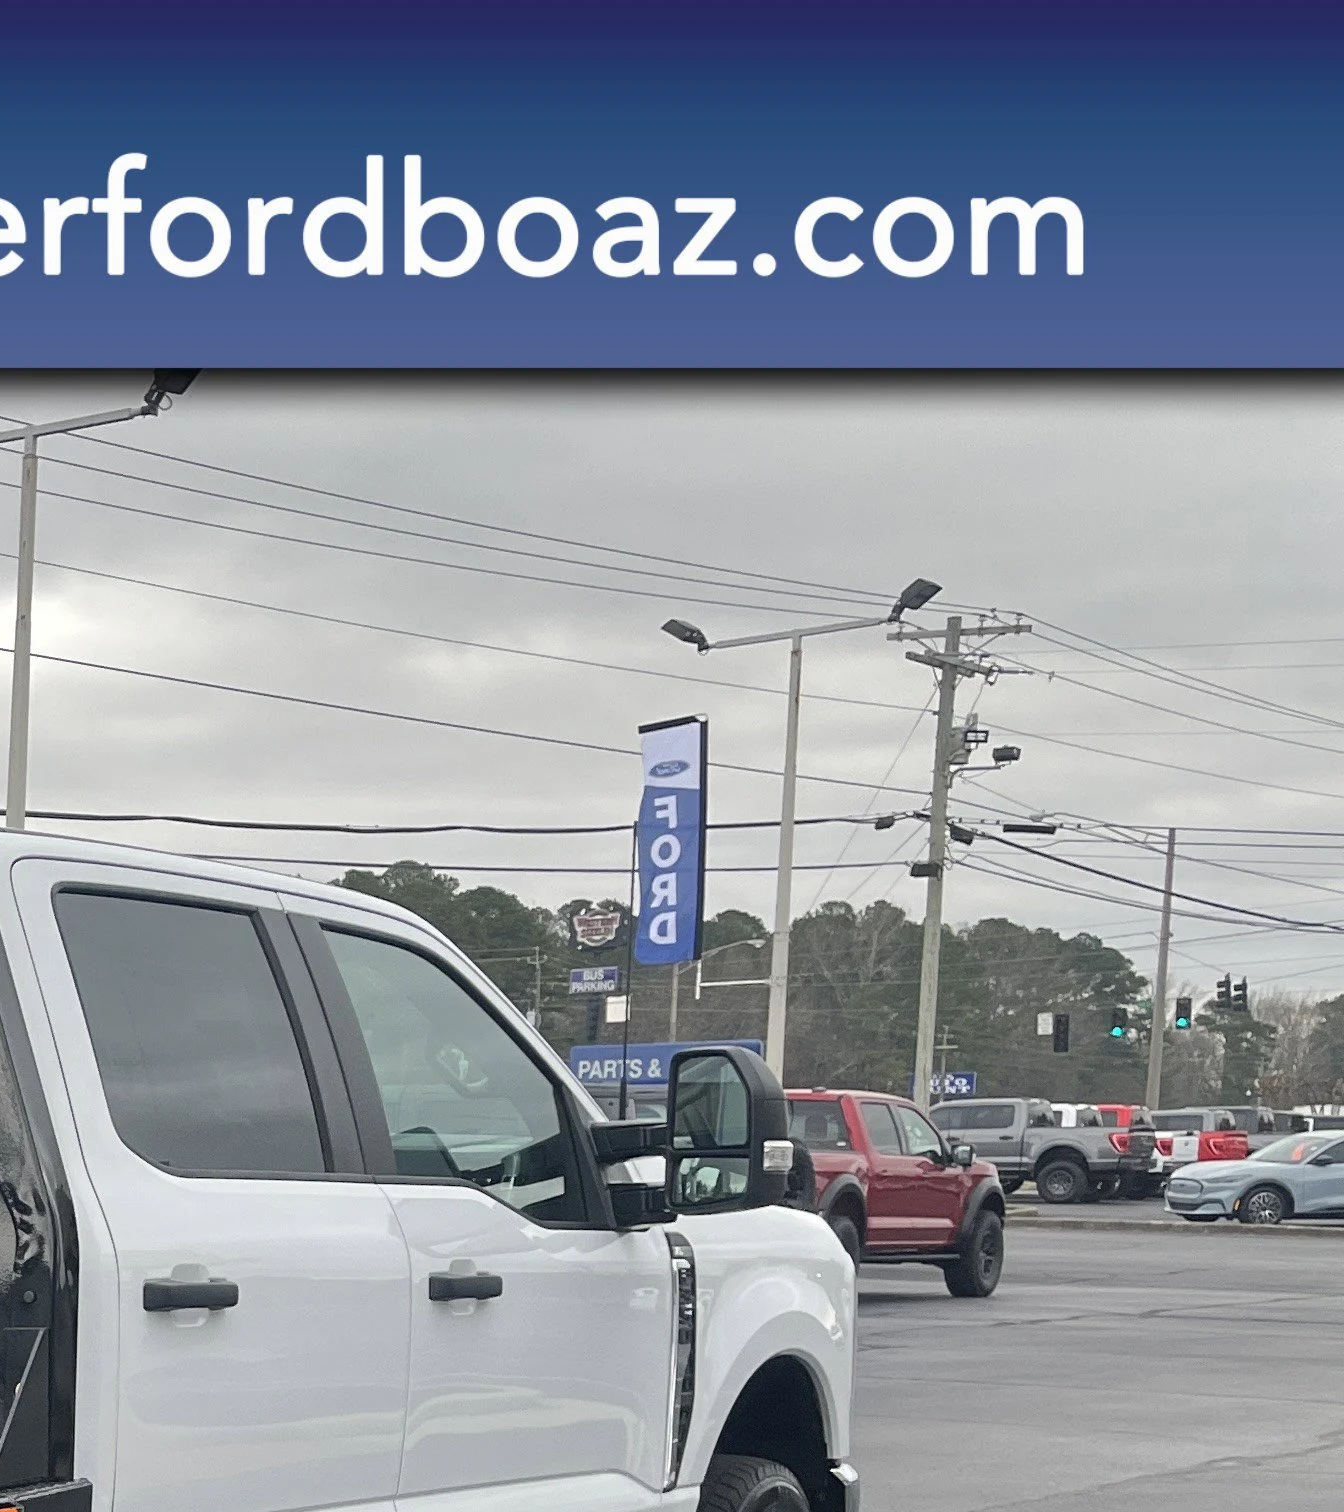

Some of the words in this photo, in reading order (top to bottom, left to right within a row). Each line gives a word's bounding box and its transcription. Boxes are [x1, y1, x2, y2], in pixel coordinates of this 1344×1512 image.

[583, 969, 605, 980] BUS
[571, 979, 615, 991] PARKING
[578, 1059, 643, 1079] PARTS
[647, 1058, 662, 1078] &
